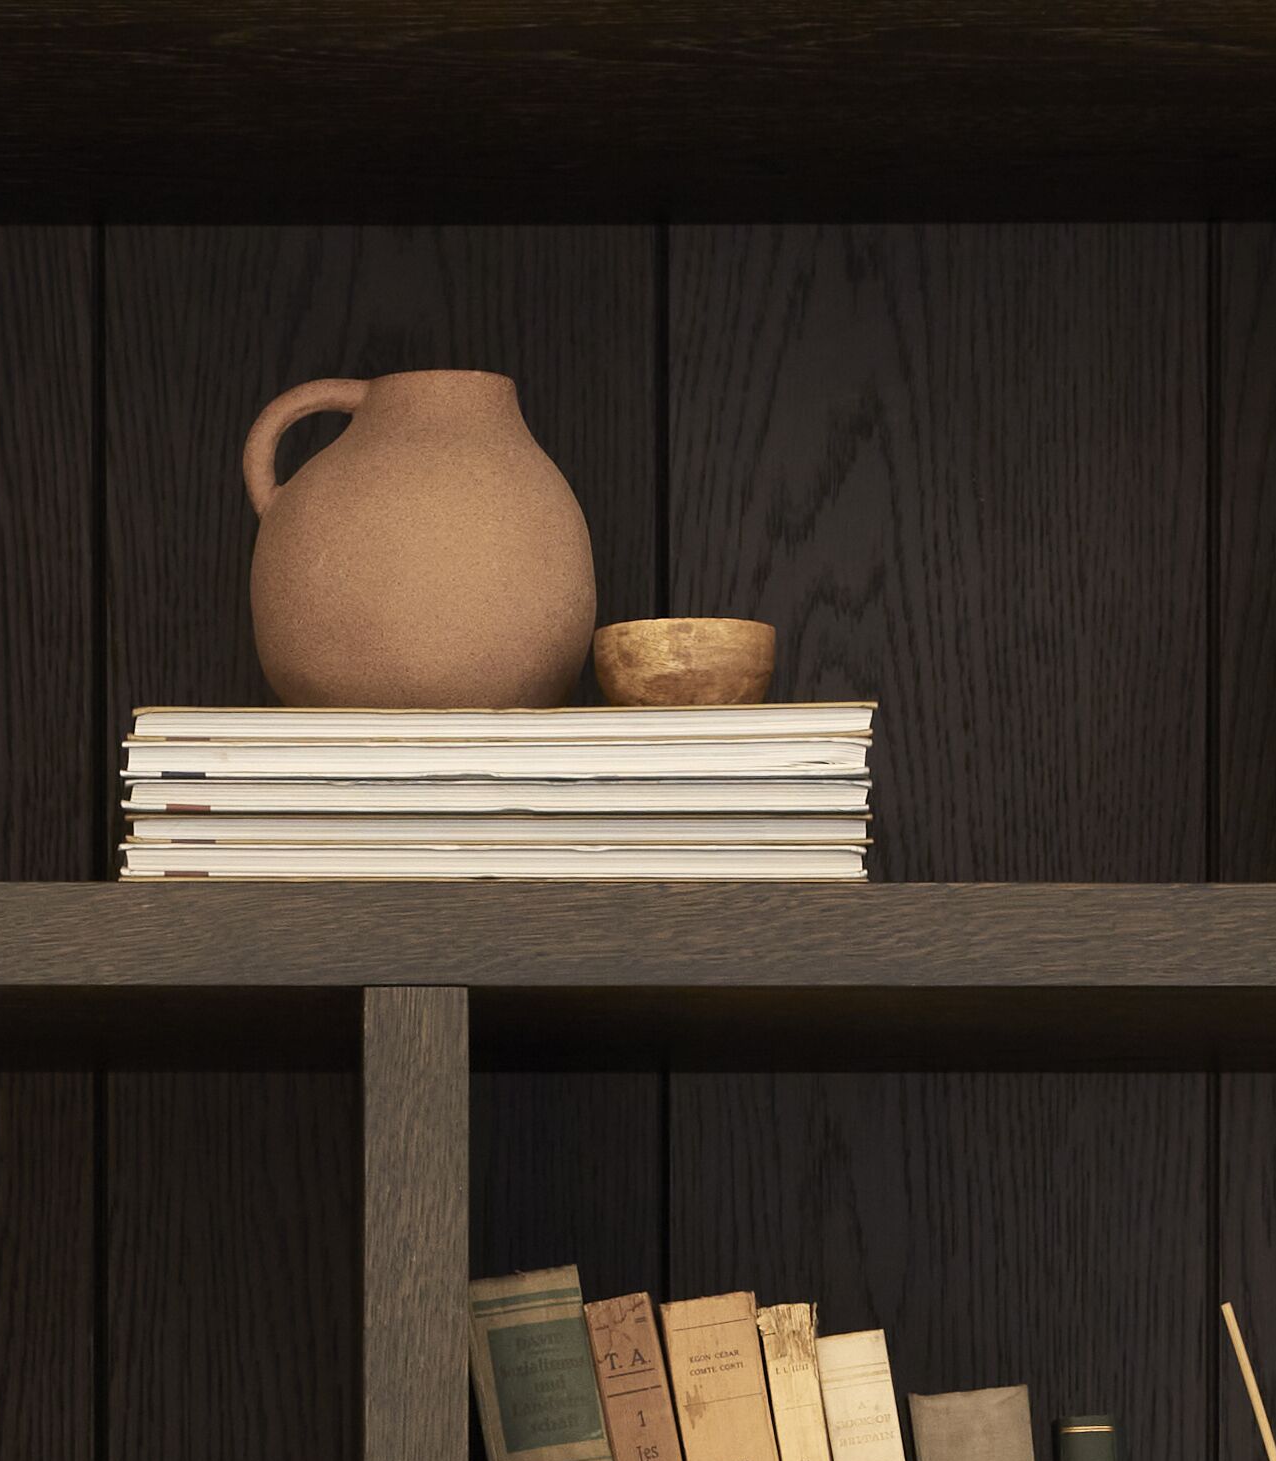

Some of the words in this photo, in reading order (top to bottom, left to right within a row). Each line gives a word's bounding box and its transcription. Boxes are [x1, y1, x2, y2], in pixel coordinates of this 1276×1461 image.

[604, 1352, 623, 1370] T.
[630, 1348, 651, 1367] A.
[689, 1353, 711, 1363] EGON
[690, 1364, 717, 1375] COMTE
[637, 1411, 646, 1427] 1
